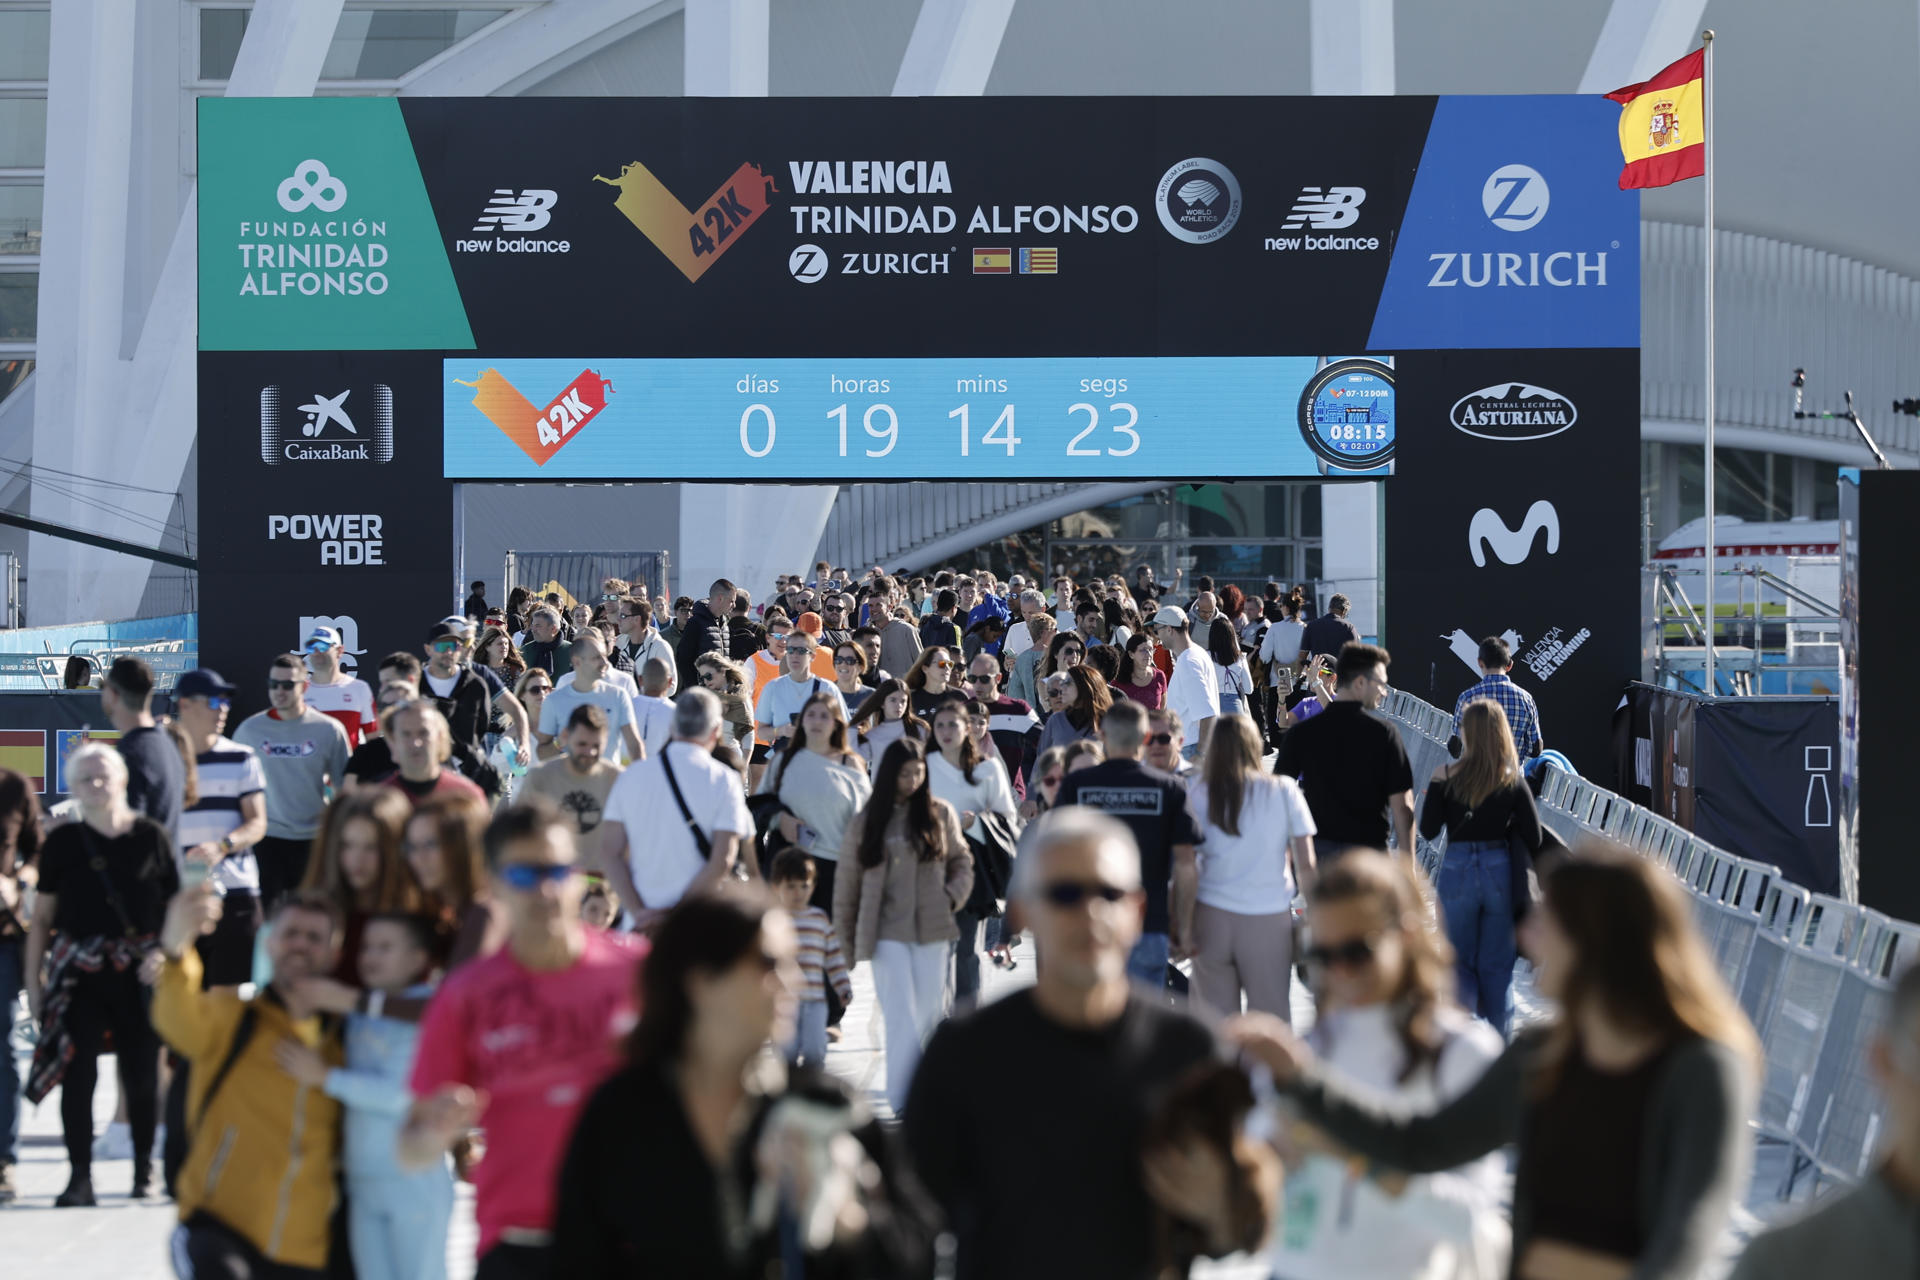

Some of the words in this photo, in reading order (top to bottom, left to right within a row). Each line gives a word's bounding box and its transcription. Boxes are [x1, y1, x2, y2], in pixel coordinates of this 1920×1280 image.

[788, 160, 952, 194] VALENCIA
[1159, 169, 1180, 202] PLATINUM
[1178, 161, 1200, 173] LABEL
[240, 218, 386, 237] FUNDACIÓN
[689, 186, 752, 257] 42K
[790, 206, 957, 234] TRINIDAD
[966, 205, 1139, 234] ALFONSO
[238, 243, 388, 268] TRINIDAD
[456, 240, 493, 253] new
[496, 236, 571, 253] balance
[1264, 238, 1302, 251] new
[1304, 235, 1380, 251] balance
[841, 253, 950, 275] ZURICH
[1427, 251, 1609, 288] ZURICH
[239, 271, 389, 296] ALFONSO
[736, 374, 779, 394] días
[831, 374, 890, 393] horas
[957, 374, 1008, 393] mins
[1080, 377, 1128, 398] segs
[535, 387, 594, 448] 42K
[1461, 404, 1567, 426] ASTURIANA
[739, 403, 776, 458] 0
[826, 403, 899, 458] 19
[948, 403, 1022, 457] 14
[1066, 402, 1141, 457] 23
[1330, 424, 1386, 440] 08:15
[284, 443, 369, 460] CaixaBank
[268, 514, 383, 540] POWER
[321, 540, 383, 566] ADE
[1521, 626, 1563, 665] VALENCIA
[1530, 640, 1563, 673] CIUDAD
[1537, 663, 1557, 681] DEL
[1552, 627, 1591, 666] RUNNING
